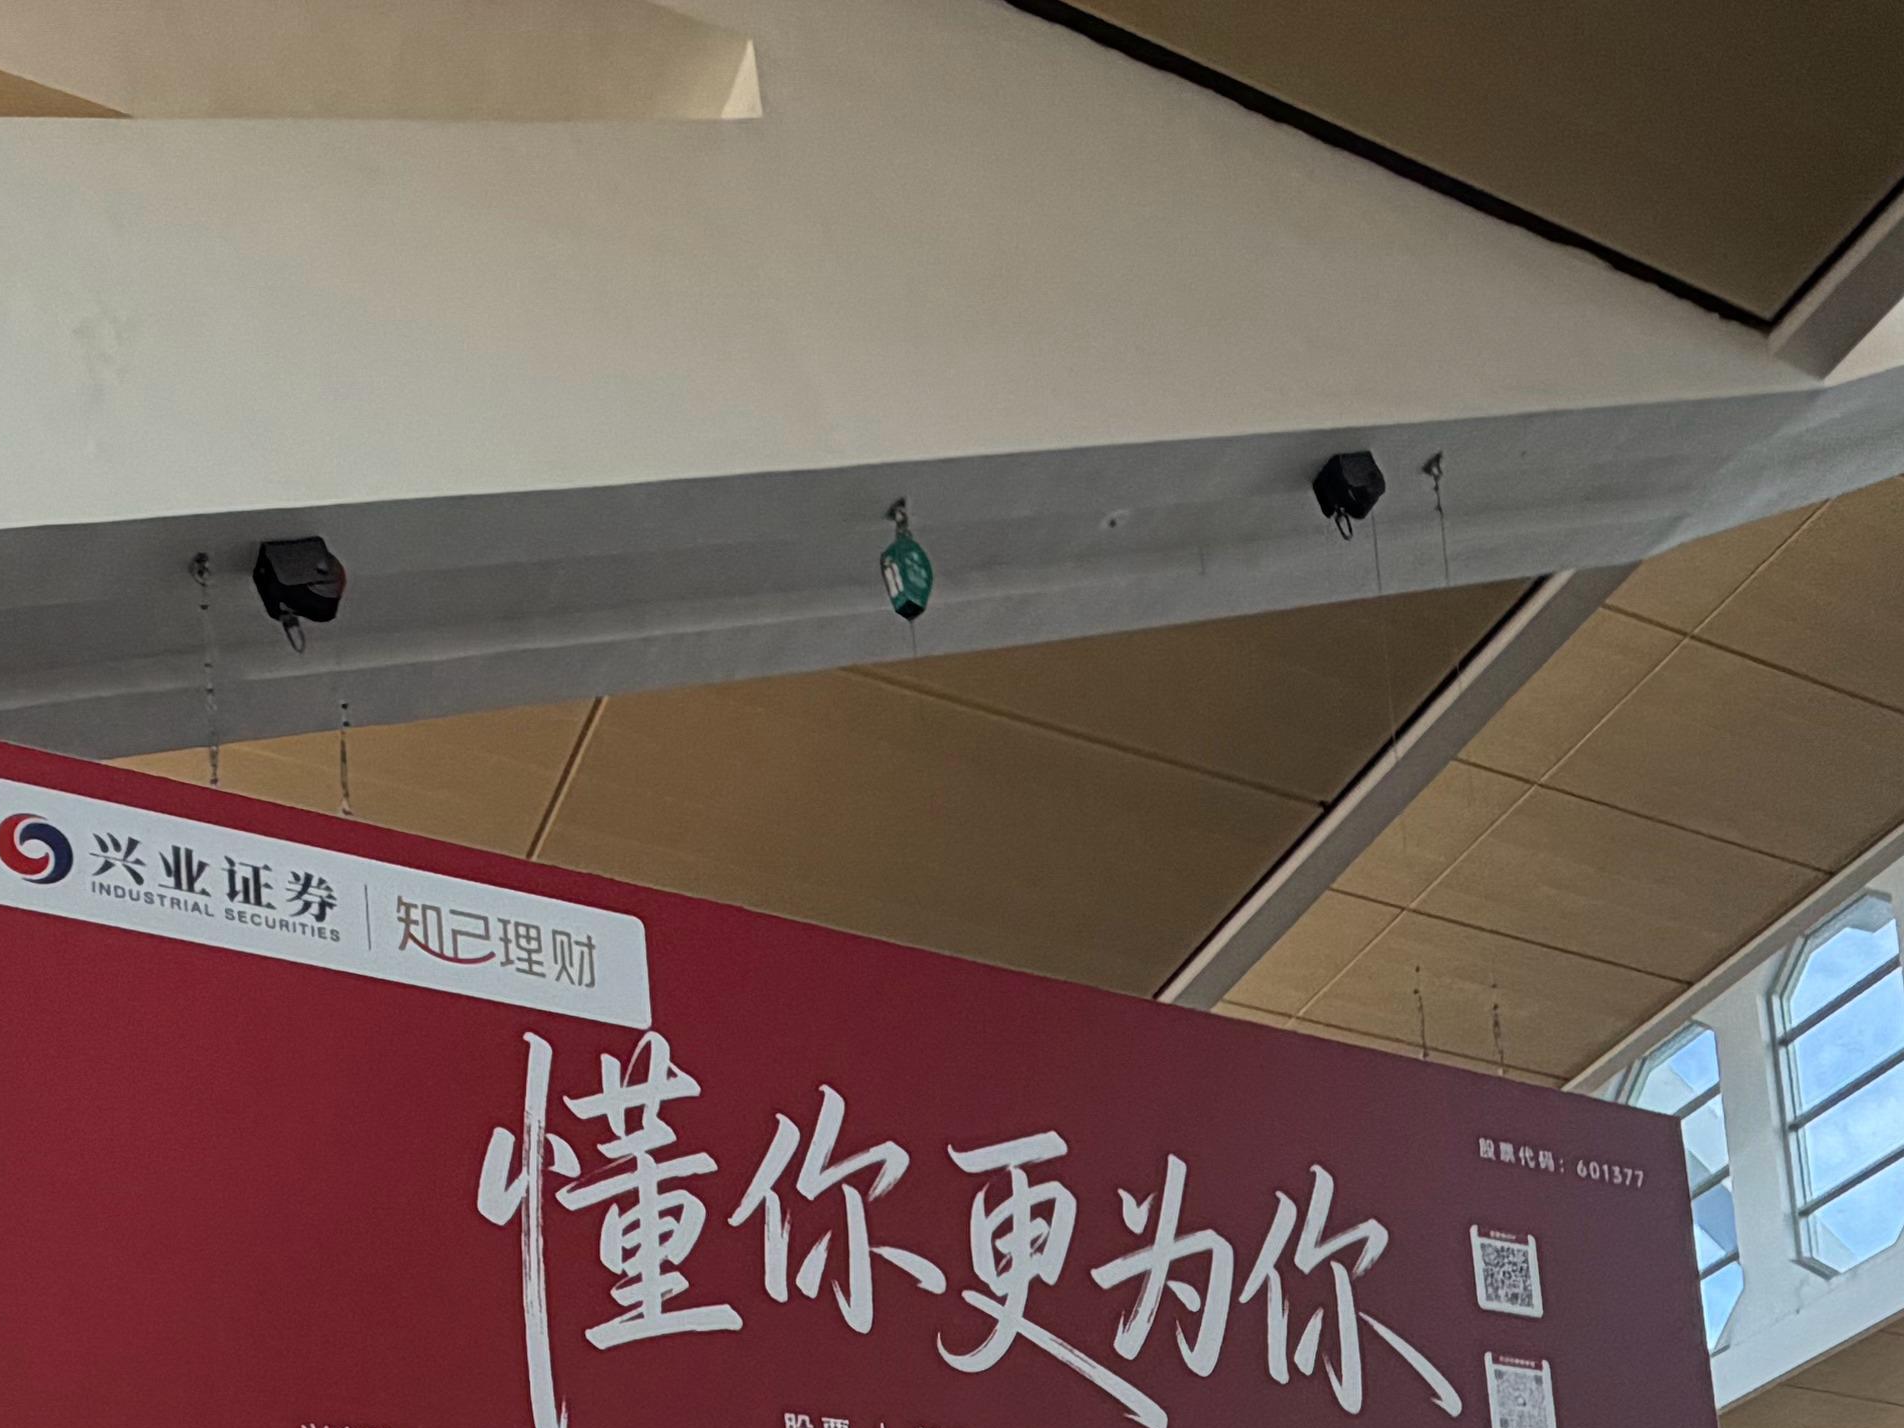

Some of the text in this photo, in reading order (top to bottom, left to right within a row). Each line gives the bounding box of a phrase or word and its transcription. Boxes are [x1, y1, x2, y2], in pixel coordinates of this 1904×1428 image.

[89, 832, 598, 990] 兴业证券 知己理财
[91, 881, 341, 942] INDUSTRIAL SECURITIES
